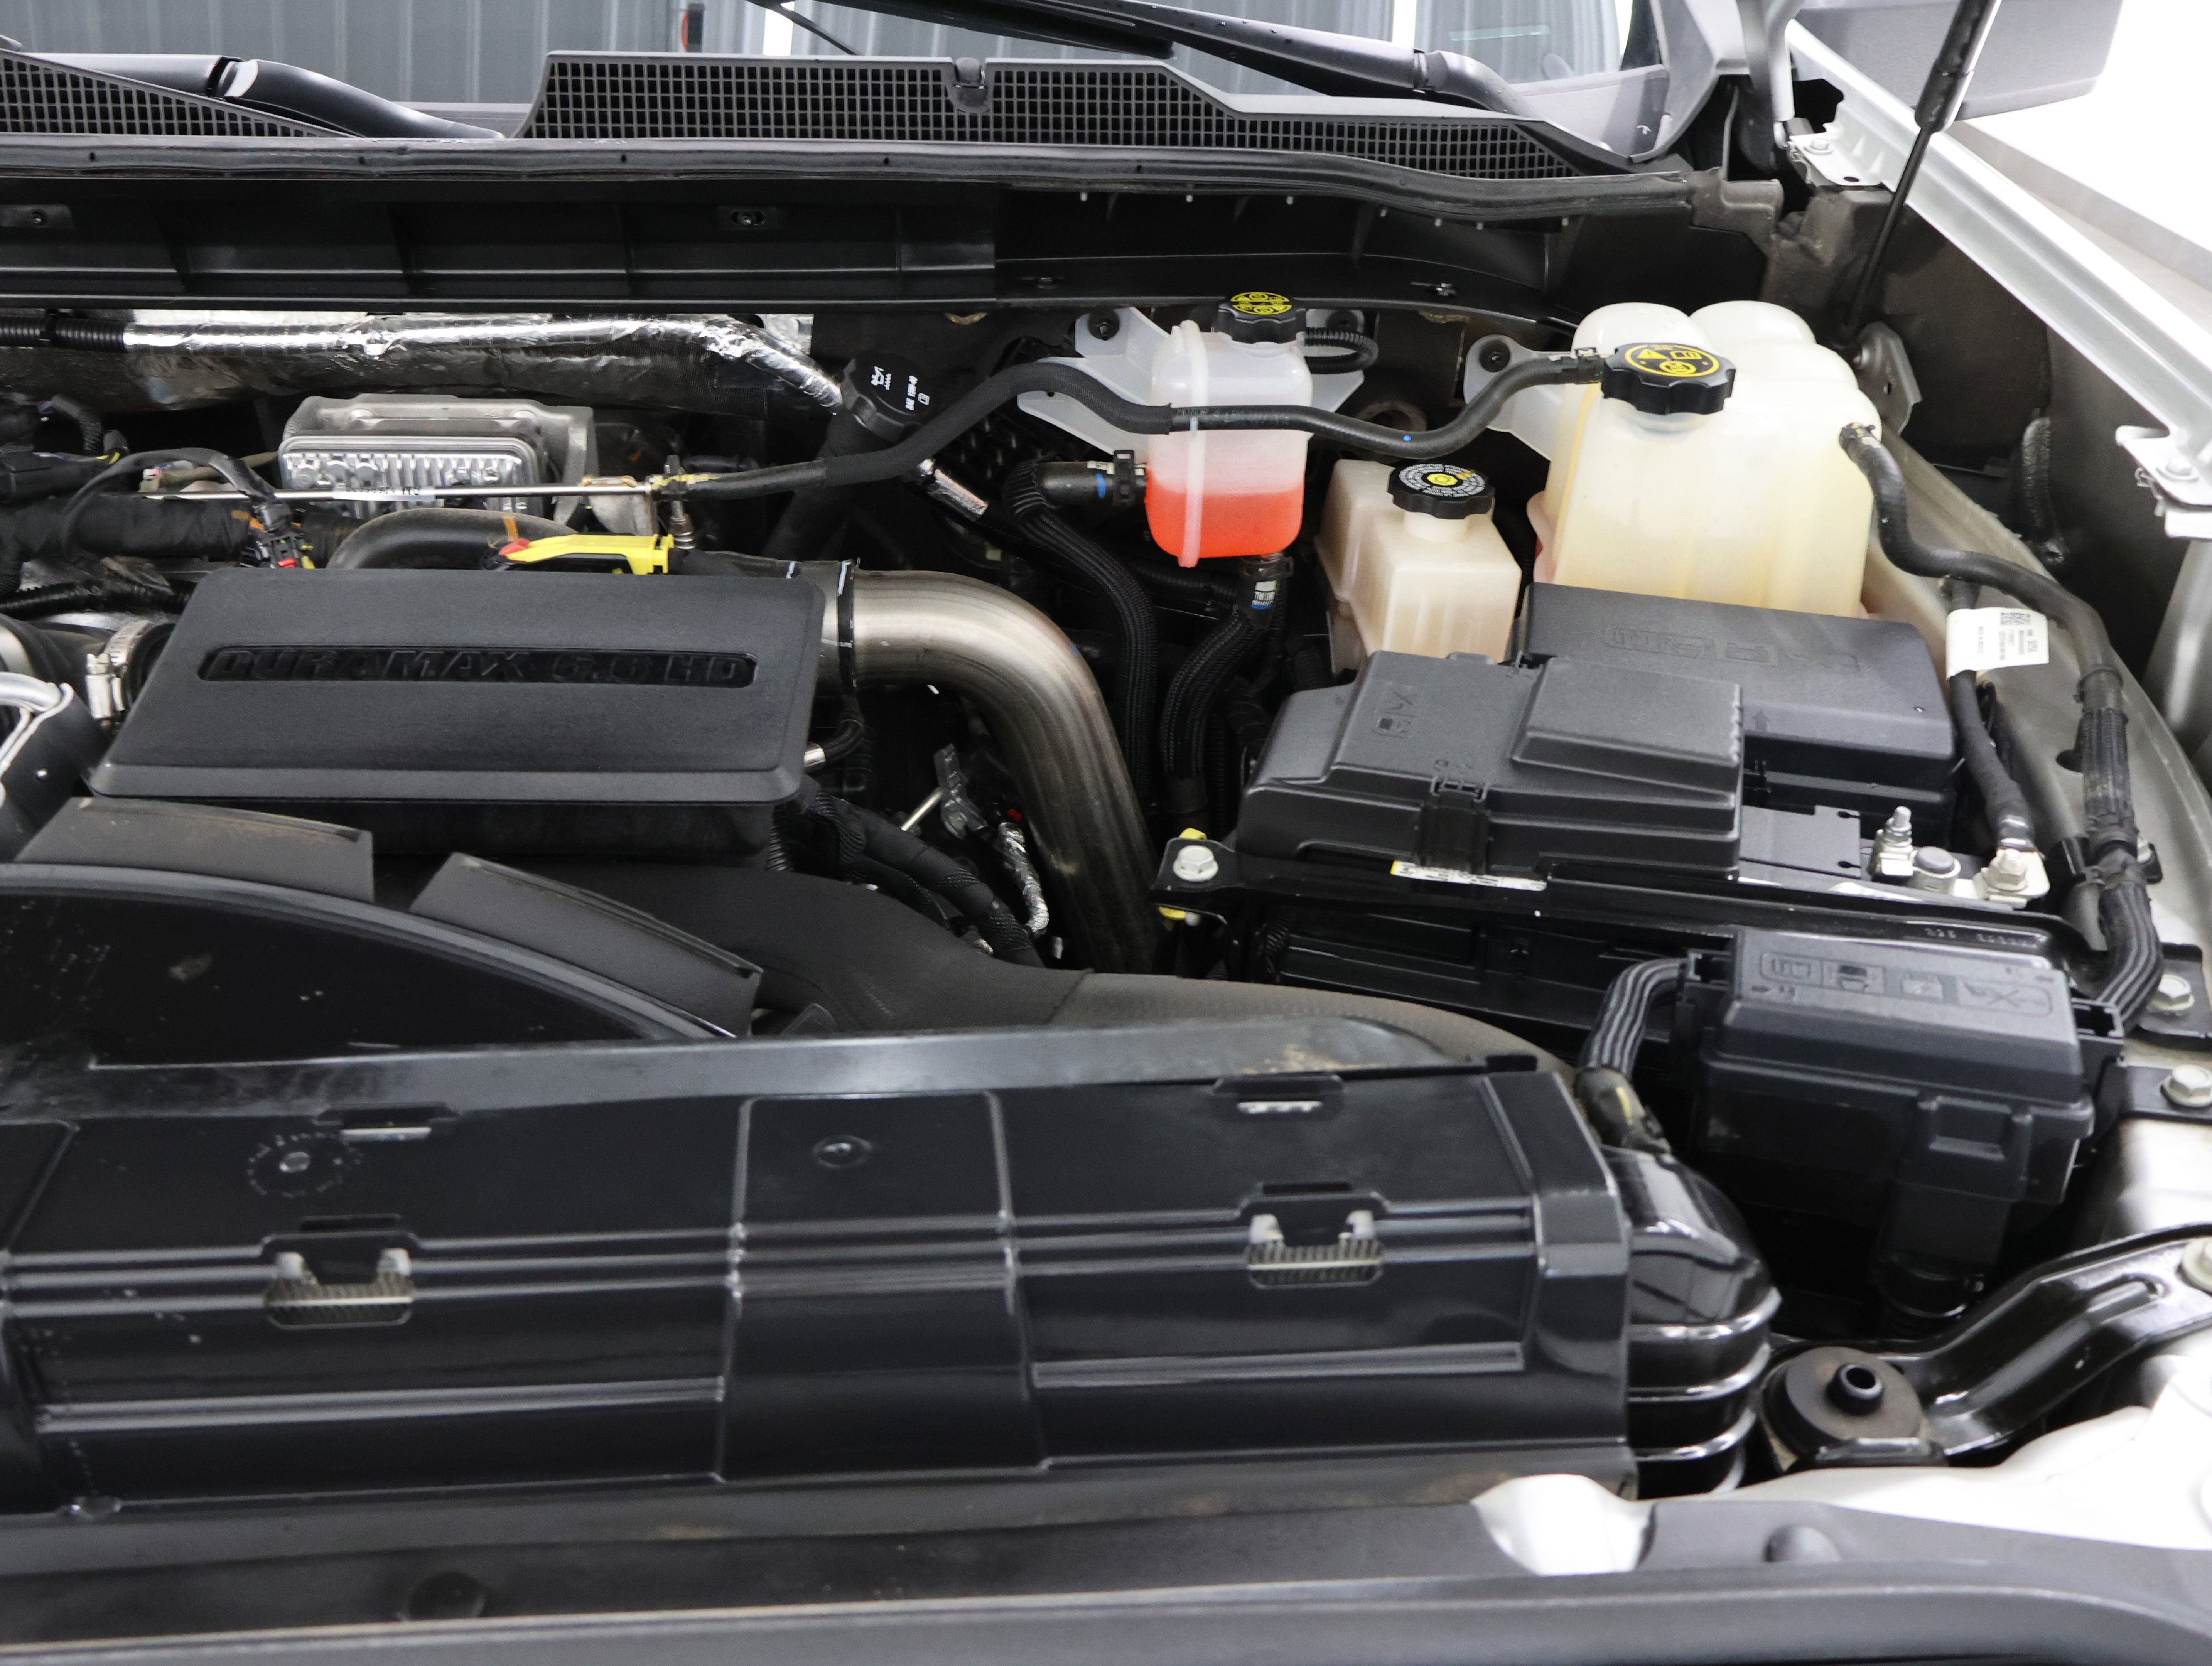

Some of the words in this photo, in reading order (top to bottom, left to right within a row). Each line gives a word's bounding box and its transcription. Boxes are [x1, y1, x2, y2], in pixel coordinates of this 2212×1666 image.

[905, 398, 915, 411] SAE
[208, 650, 529, 680] DURAMAX
[551, 654, 653, 683] 6.6
[663, 655, 746, 684] HD
